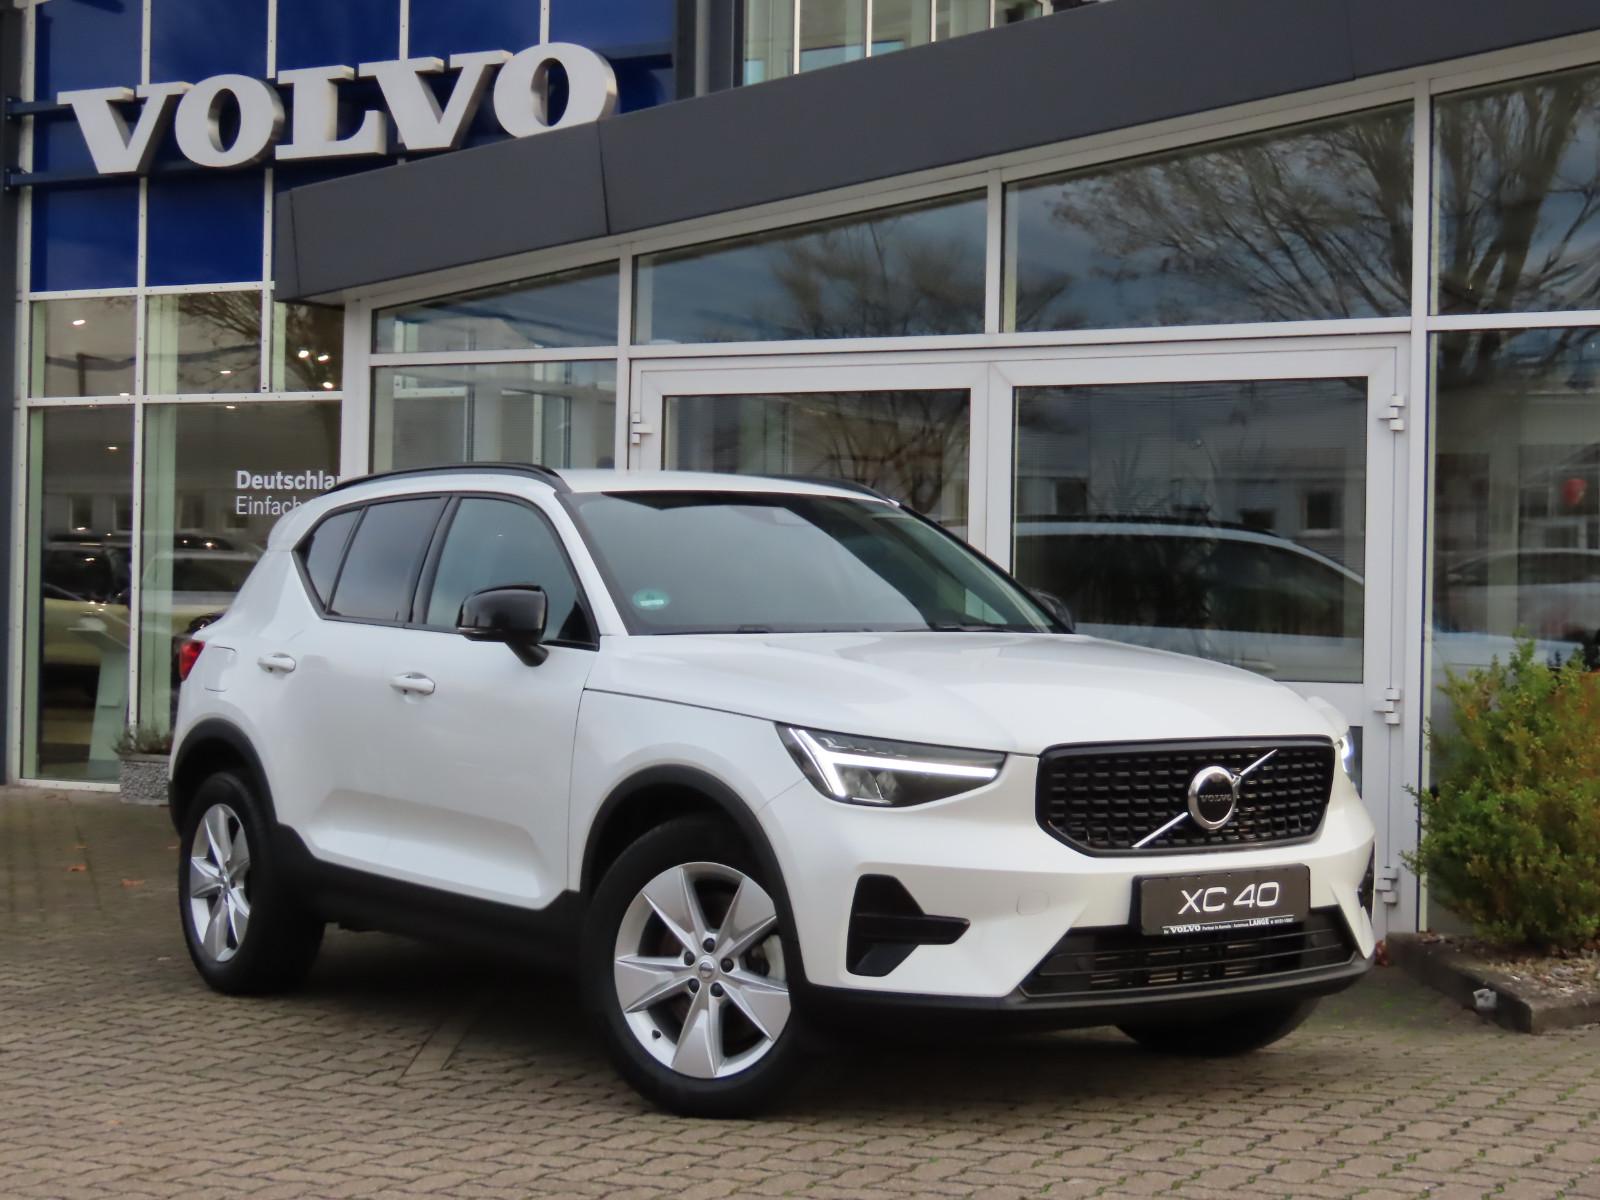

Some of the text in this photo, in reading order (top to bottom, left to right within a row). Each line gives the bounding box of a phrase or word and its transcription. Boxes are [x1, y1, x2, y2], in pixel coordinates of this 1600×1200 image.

[57, 41, 619, 175] VOLVO
[1199, 793, 1232, 803] VOLVO
[1178, 881, 1280, 915] XC 40
[1170, 924, 1201, 934] VOLVO
